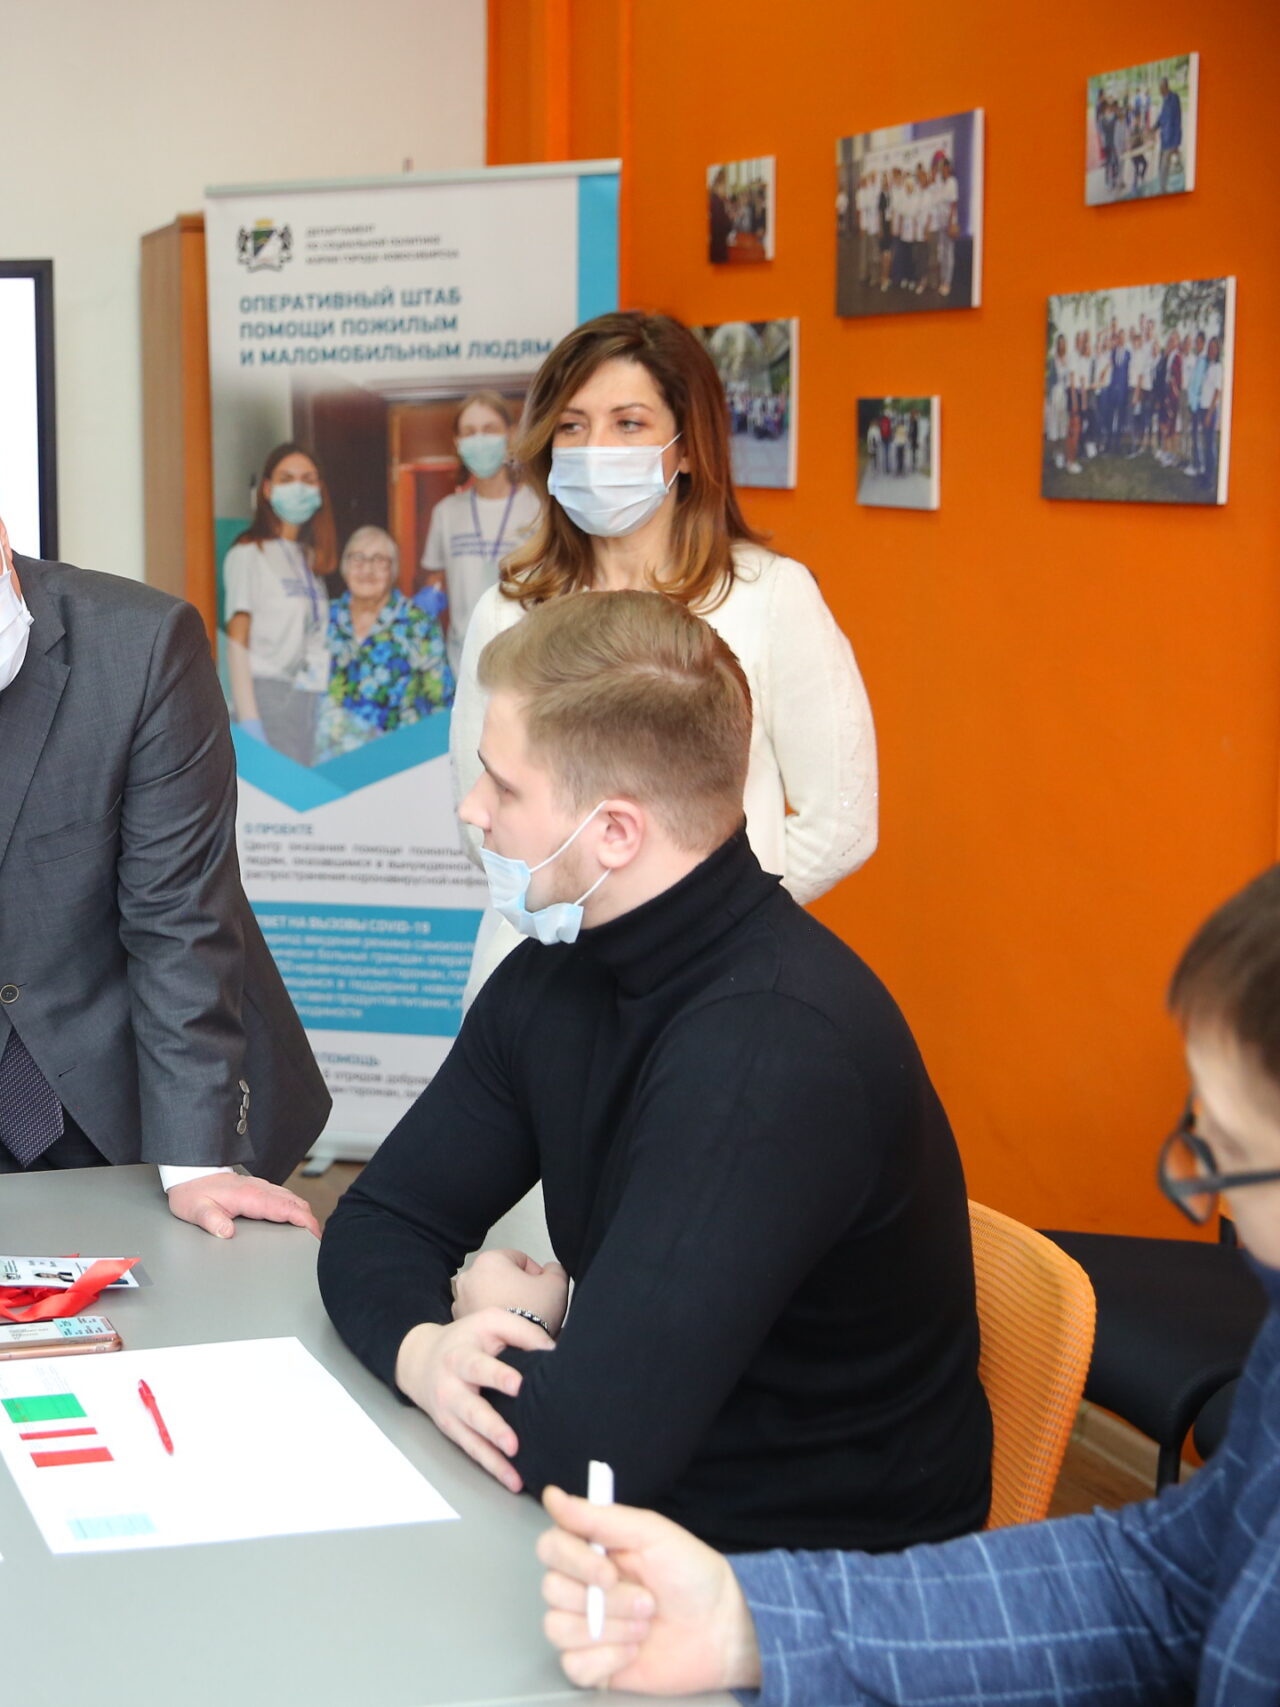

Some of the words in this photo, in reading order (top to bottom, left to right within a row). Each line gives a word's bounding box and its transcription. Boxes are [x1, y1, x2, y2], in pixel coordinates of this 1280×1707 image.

[240, 286, 394, 313] ОПЕРАТИВНЫЙ
[400, 287, 462, 307] ШТАБ
[240, 320, 334, 340] ПОМОЩИ
[341, 315, 458, 334] ПОЖИЛЫМ
[240, 348, 254, 366] И
[261, 343, 460, 365] МАЛОМОБИЛЬНЫМ
[468, 338, 552, 362] ЛЮДЯМ
[368, 919, 432, 935] COVID-19
